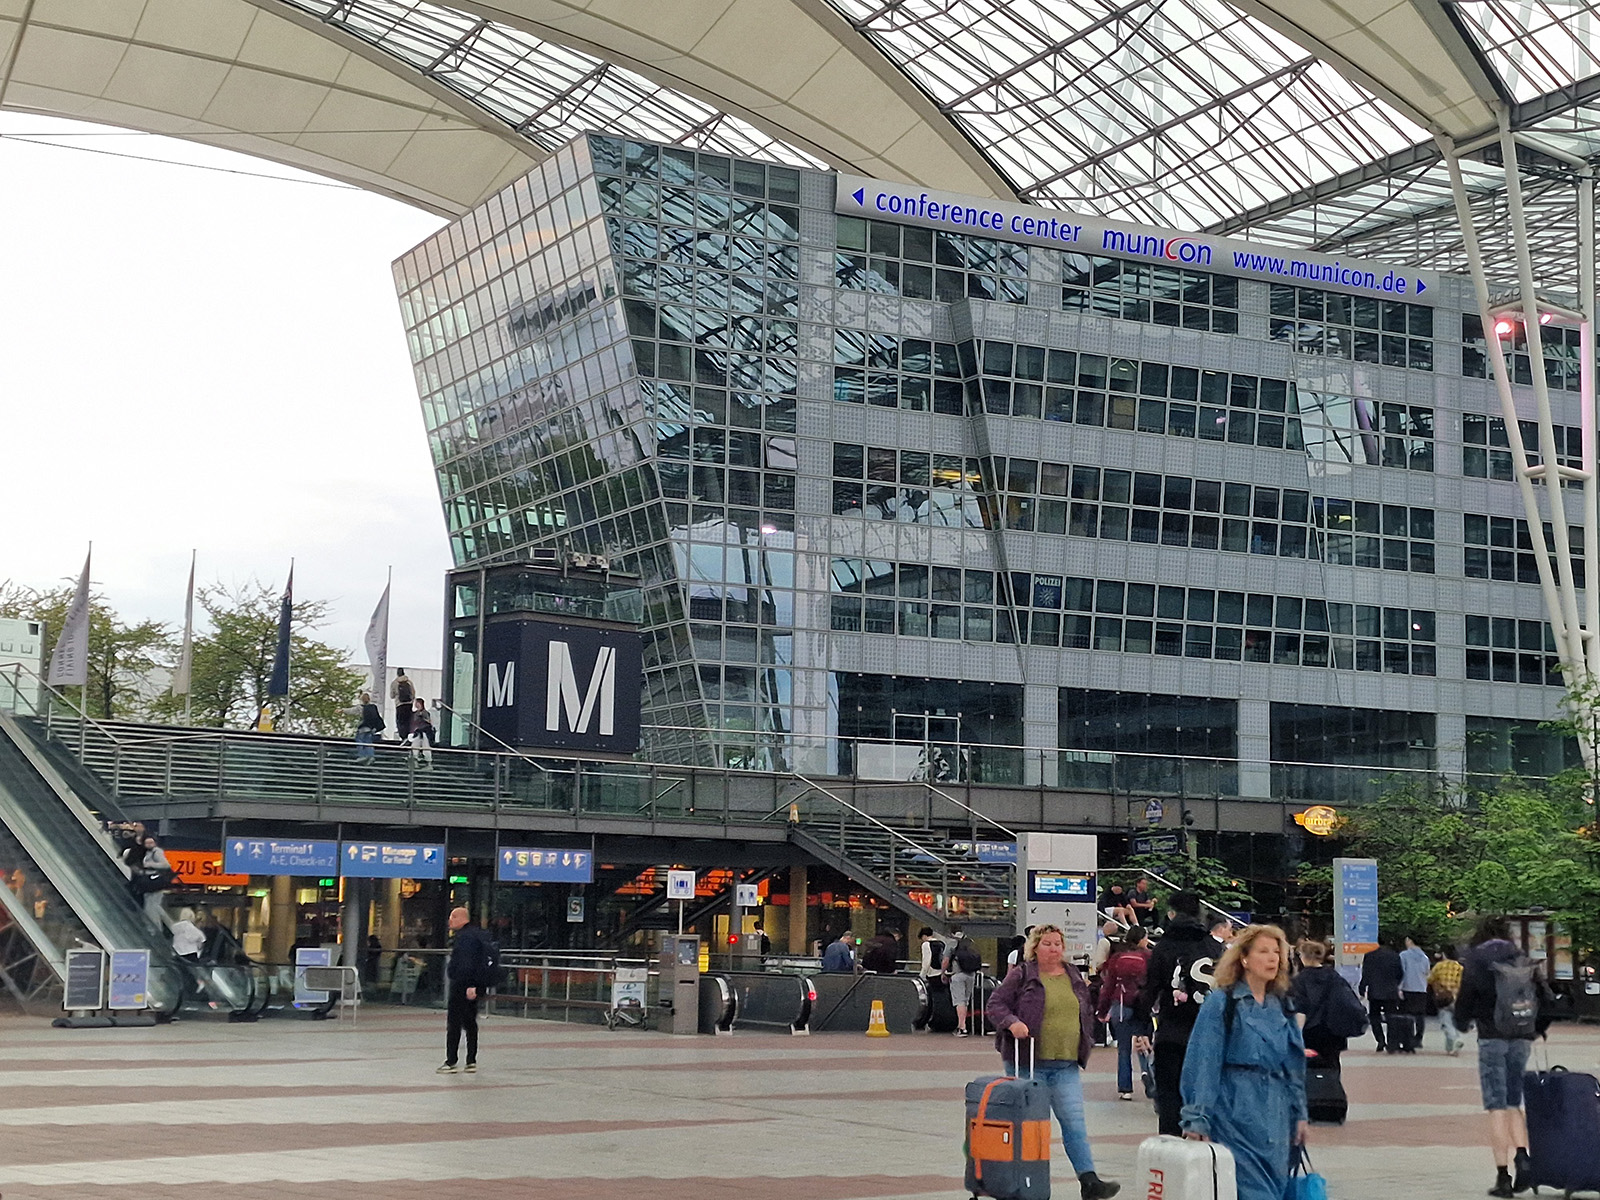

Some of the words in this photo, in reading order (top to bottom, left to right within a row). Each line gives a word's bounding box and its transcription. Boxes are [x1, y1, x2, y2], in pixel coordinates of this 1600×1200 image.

[875, 191, 1004, 230] conference
[1010, 213, 1083, 242] center
[1102, 228, 1212, 265] municon
[1232, 250, 1407, 294] www.municon.de
[1034, 576, 1061, 587] POLIZEI
[487, 660, 515, 708] M
[546, 640, 616, 736] M
[270, 842, 306, 855] Terminal
[308, 844, 313, 855] 1
[289, 855, 326, 867] Check-in
[327, 856, 334, 867] Z
